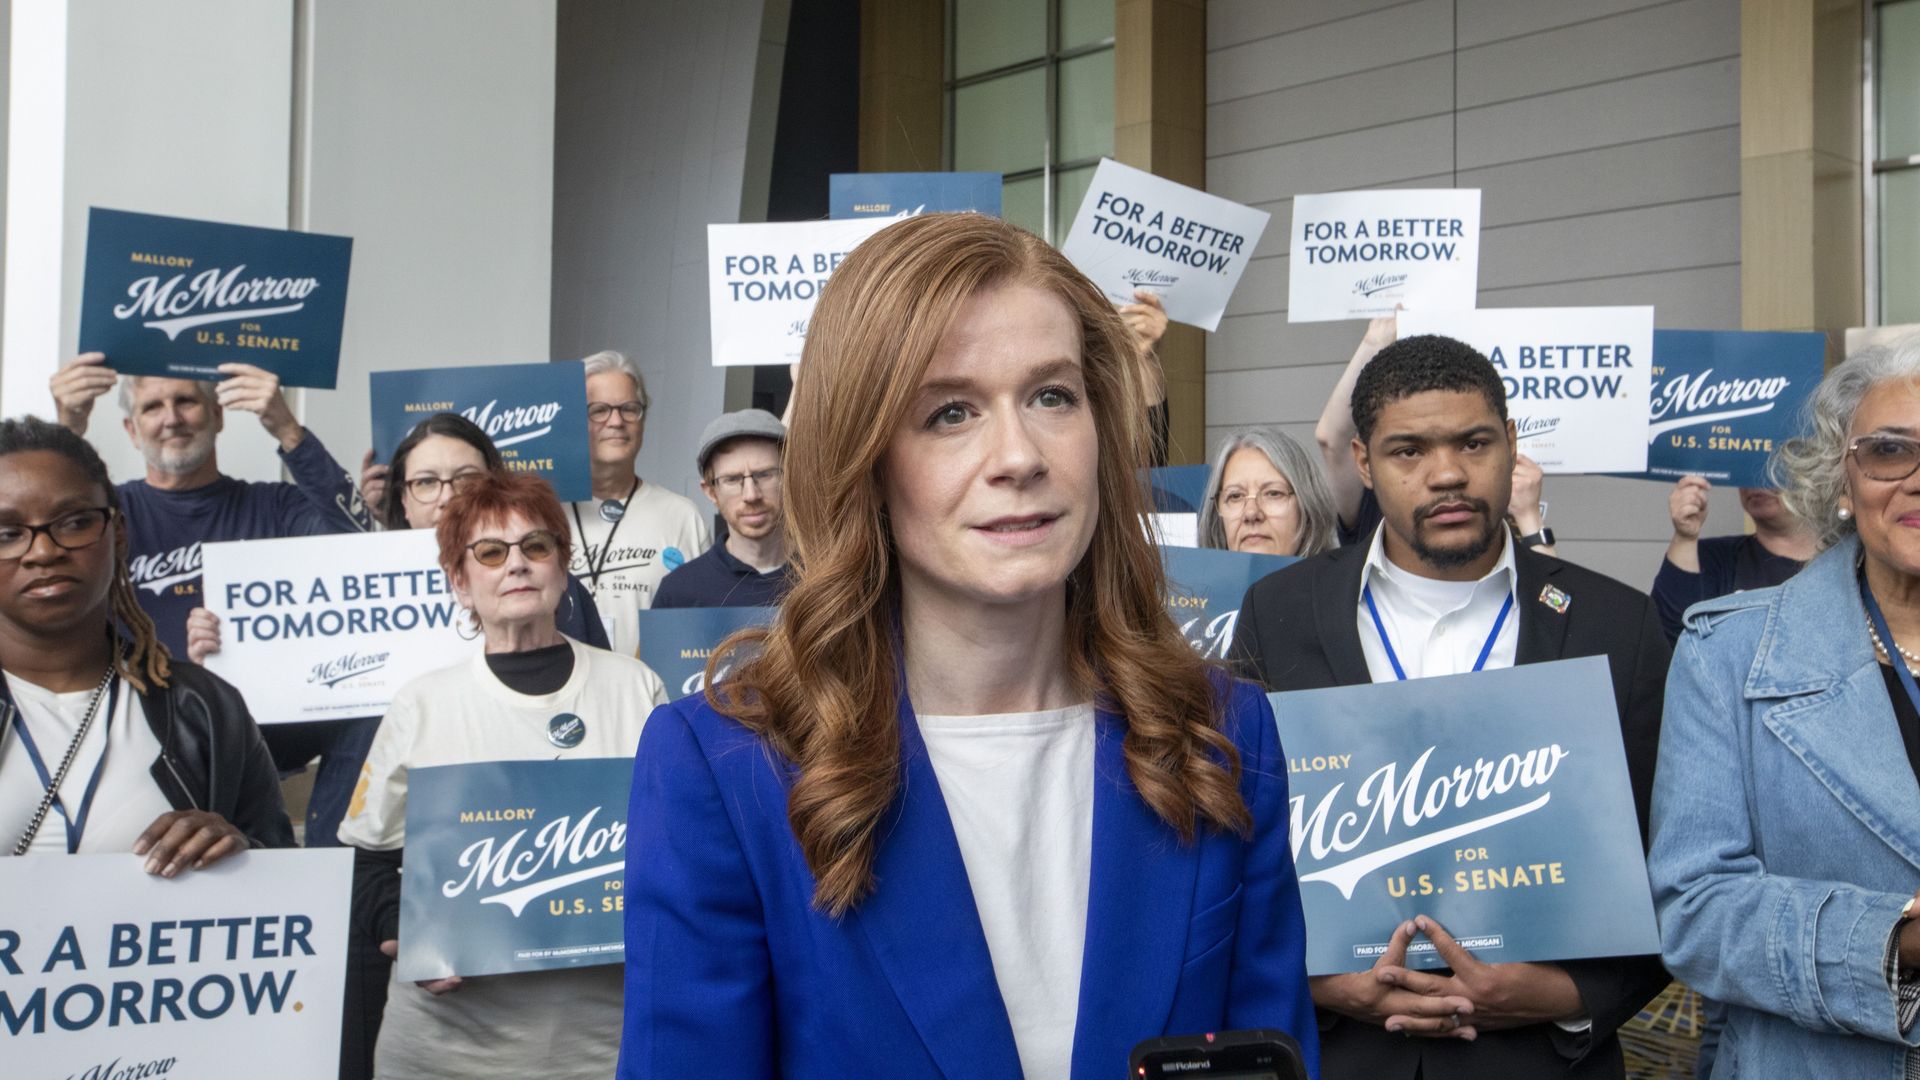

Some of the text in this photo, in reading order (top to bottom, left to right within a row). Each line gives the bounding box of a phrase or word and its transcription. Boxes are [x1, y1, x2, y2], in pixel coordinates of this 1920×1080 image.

[854, 204, 890, 213] MALLORY
[1097, 191, 1244, 254] FOR A BETTER
[1304, 218, 1464, 241] FOR A BETTER
[1092, 215, 1228, 275] TOMORROW.
[1305, 242, 1460, 265] TOMORROW.
[131, 252, 194, 268] MALLORY
[725, 255, 779, 276] FOR
[787, 254, 805, 275] A
[114, 264, 320, 320] McMorrow
[728, 279, 826, 302] TOMO
[241, 323, 261, 332] FOR
[197, 331, 300, 351] U.S. SENATE
[1490, 345, 1633, 369] A BETTER
[1502, 375, 1628, 400] ORROW.
[404, 402, 454, 412] MALLORY
[461, 399, 562, 436] Morrow
[1711, 425, 1731, 434] FOR
[501, 450, 518, 458] FOR
[1671, 435, 1773, 452] U.S. SENATE
[226, 579, 297, 610] FOR
[307, 577, 331, 604] A
[612, 583, 649, 592] SENATE
[307, 651, 390, 683] McMorrow
[1288, 754, 1351, 773] LLORY
[1290, 743, 1570, 864] McMorrow
[460, 808, 536, 823] MALLORY
[442, 806, 627, 898] McMor
[1455, 848, 1489, 862] FOR
[1387, 862, 1566, 898] U.S. SENATE
[549, 899, 593, 916] U.S.
[41, 925, 87, 974] A
[108, 914, 317, 969] BETTER
[1357, 946, 1373, 955] PAID
[1461, 937, 1500, 948] MICHIGAN
[0, 969, 304, 1037] MORROW.
[1176, 1060, 1210, 1071] Roland
